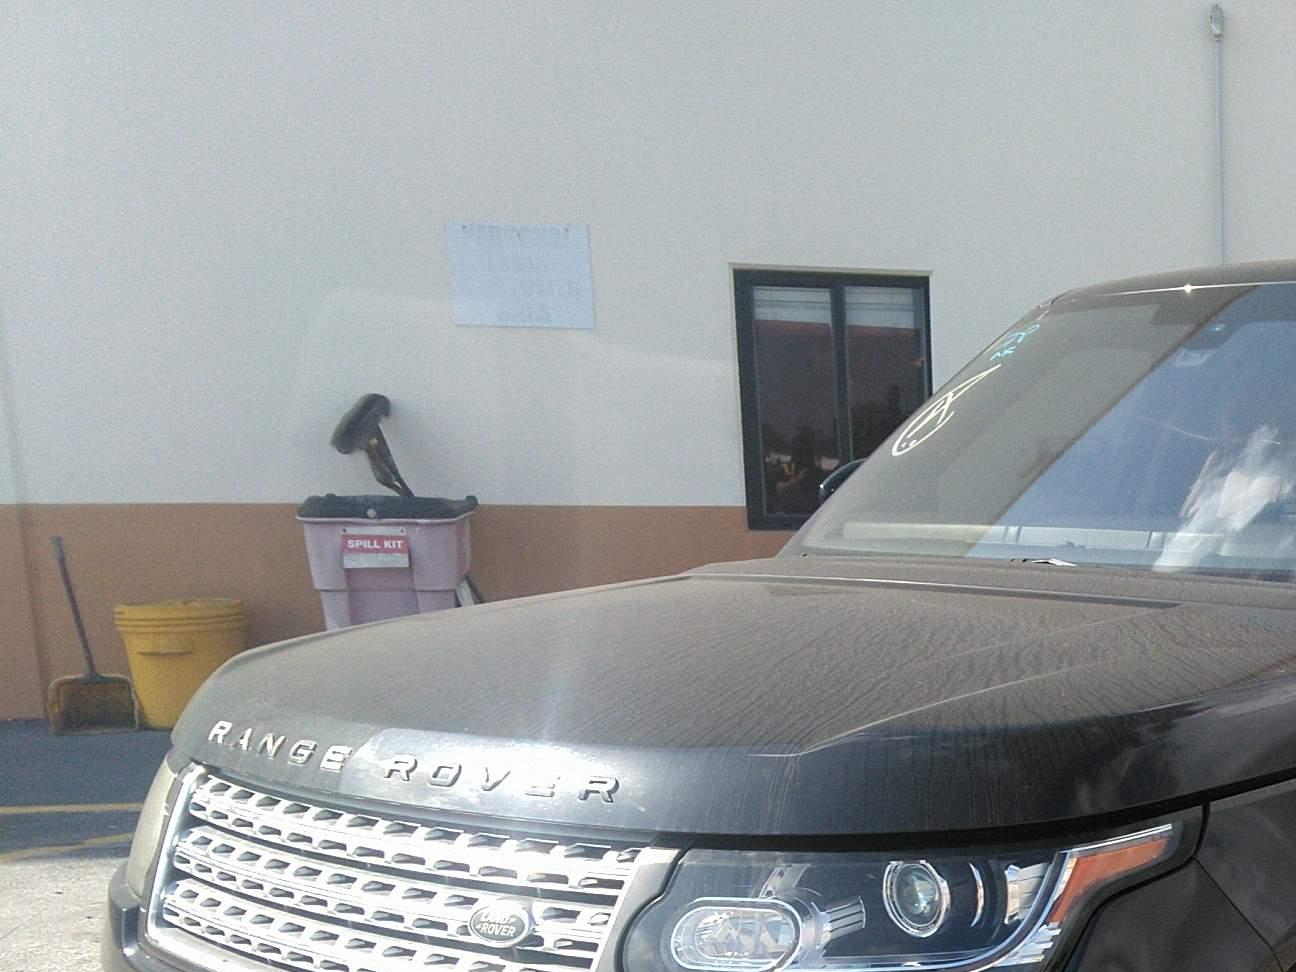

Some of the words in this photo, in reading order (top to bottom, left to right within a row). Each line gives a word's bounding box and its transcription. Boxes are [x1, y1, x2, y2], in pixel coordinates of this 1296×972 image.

[347, 539, 381, 549] SPILL
[383, 539, 404, 549] KIT
[208, 720, 353, 773] RANGE
[383, 753, 620, 804] ROVER
[480, 922, 516, 937] ROVER
